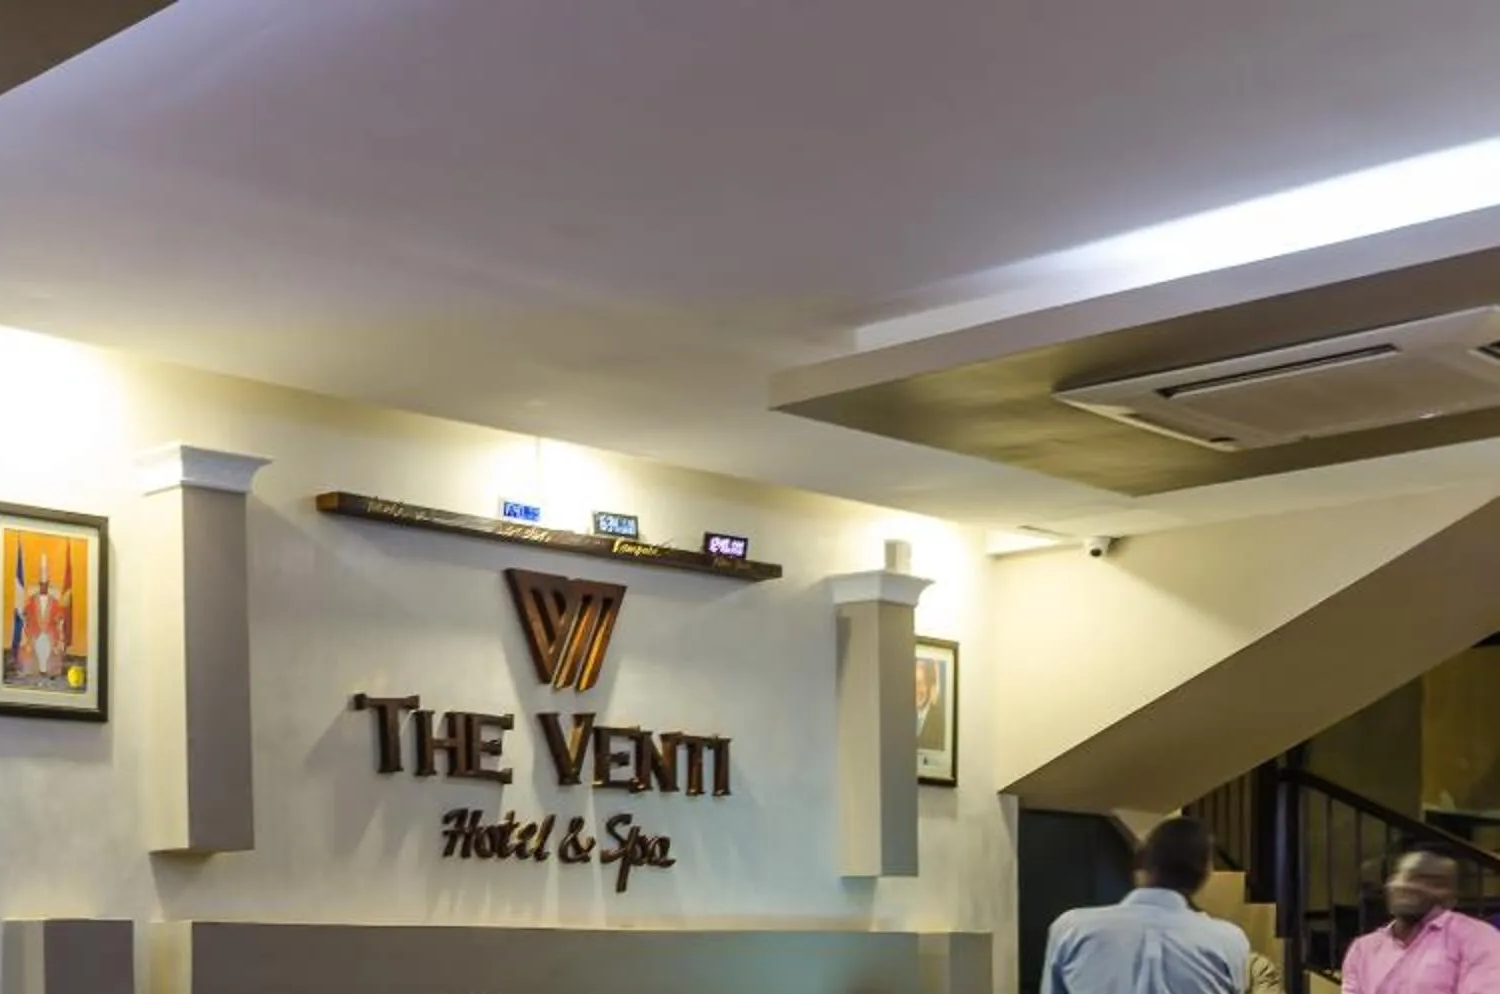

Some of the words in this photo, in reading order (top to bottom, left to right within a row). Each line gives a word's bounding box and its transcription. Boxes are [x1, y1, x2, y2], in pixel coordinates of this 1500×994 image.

[353, 693, 514, 784] THE
[537, 713, 731, 796] VENTI
[442, 808, 556, 862] Hotel
[558, 816, 596, 863] &
[600, 813, 676, 893] Spa
